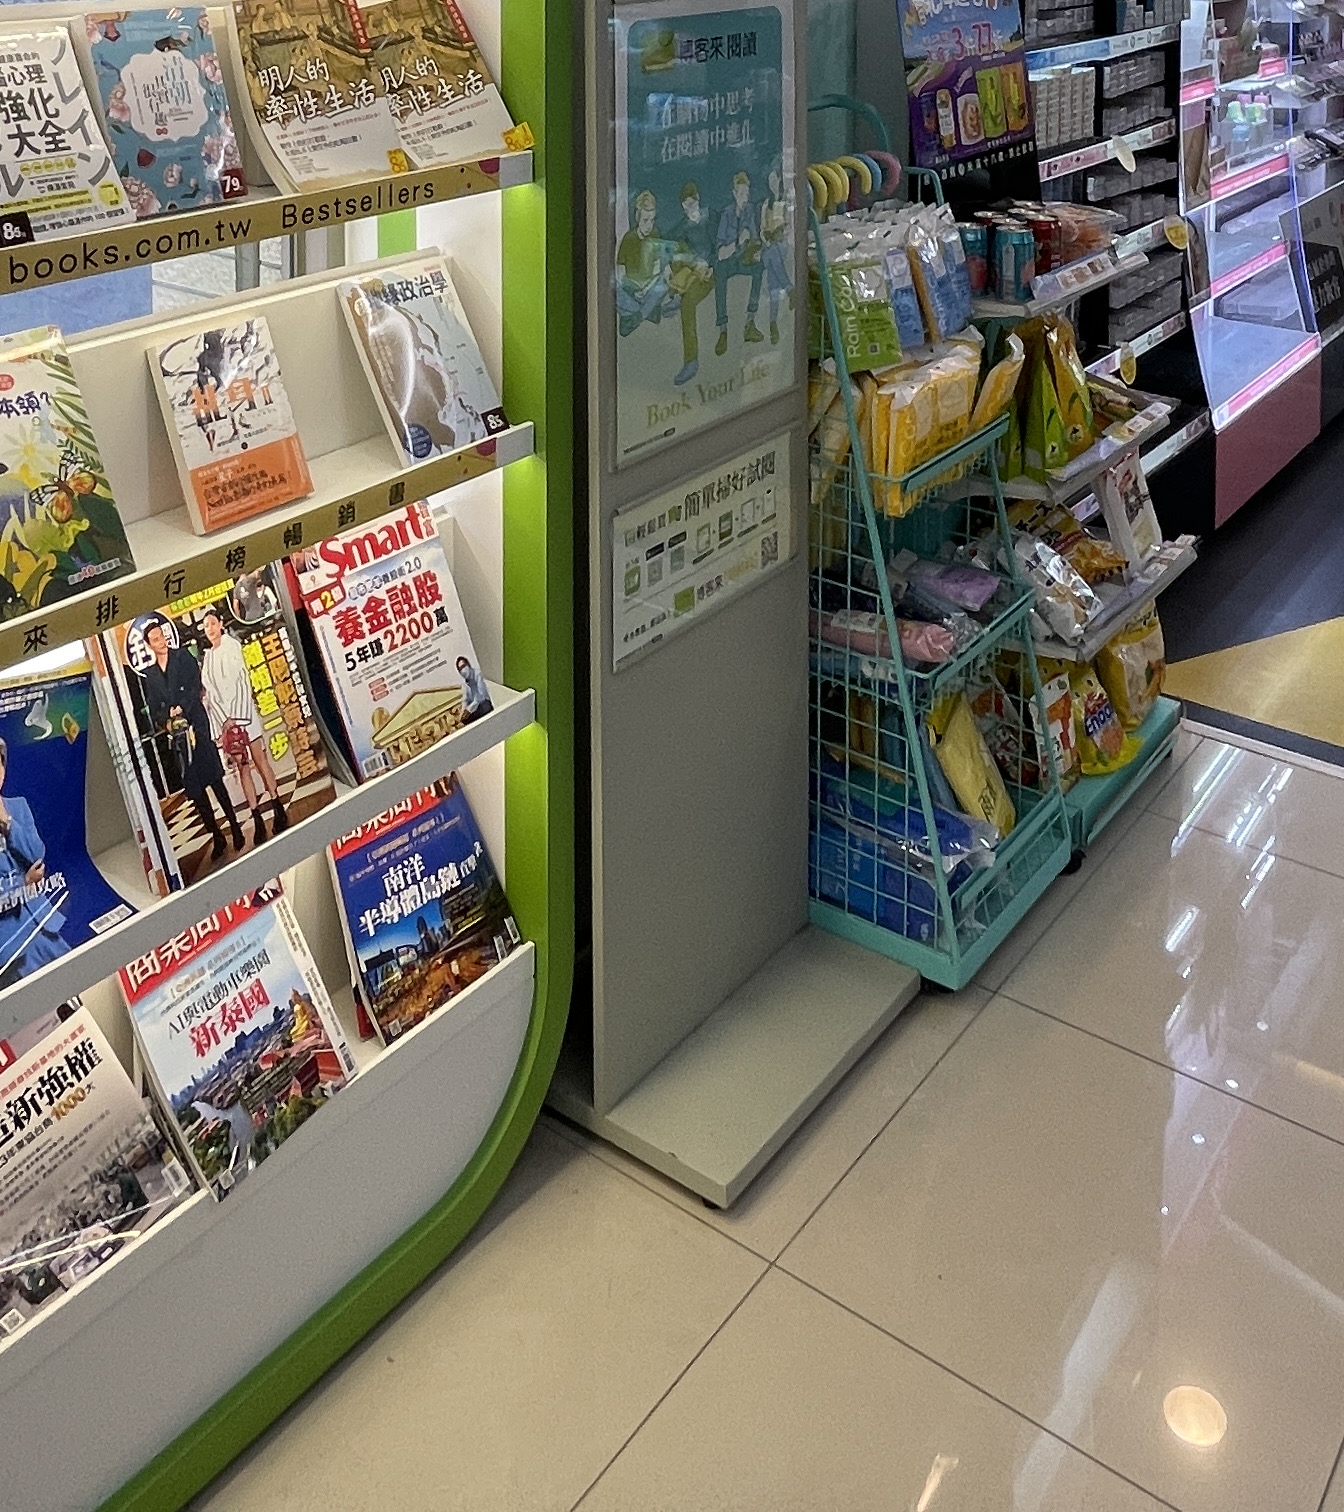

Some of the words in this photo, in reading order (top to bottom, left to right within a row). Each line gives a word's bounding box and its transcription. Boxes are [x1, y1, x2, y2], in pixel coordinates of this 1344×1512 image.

[258, 58, 329, 94] 明人的
[265, 78, 376, 130] 率性生活
[7, 120, 72, 158] 大全
[9, 214, 253, 285] books.com.tw
[282, 178, 435, 228] Bestsellers
[646, 392, 692, 429] Book
[697, 381, 735, 406] Your
[320, 503, 423, 579] Smart
[332, 570, 443, 648] 養金融股
[187, 978, 272, 1059] 新泰國
